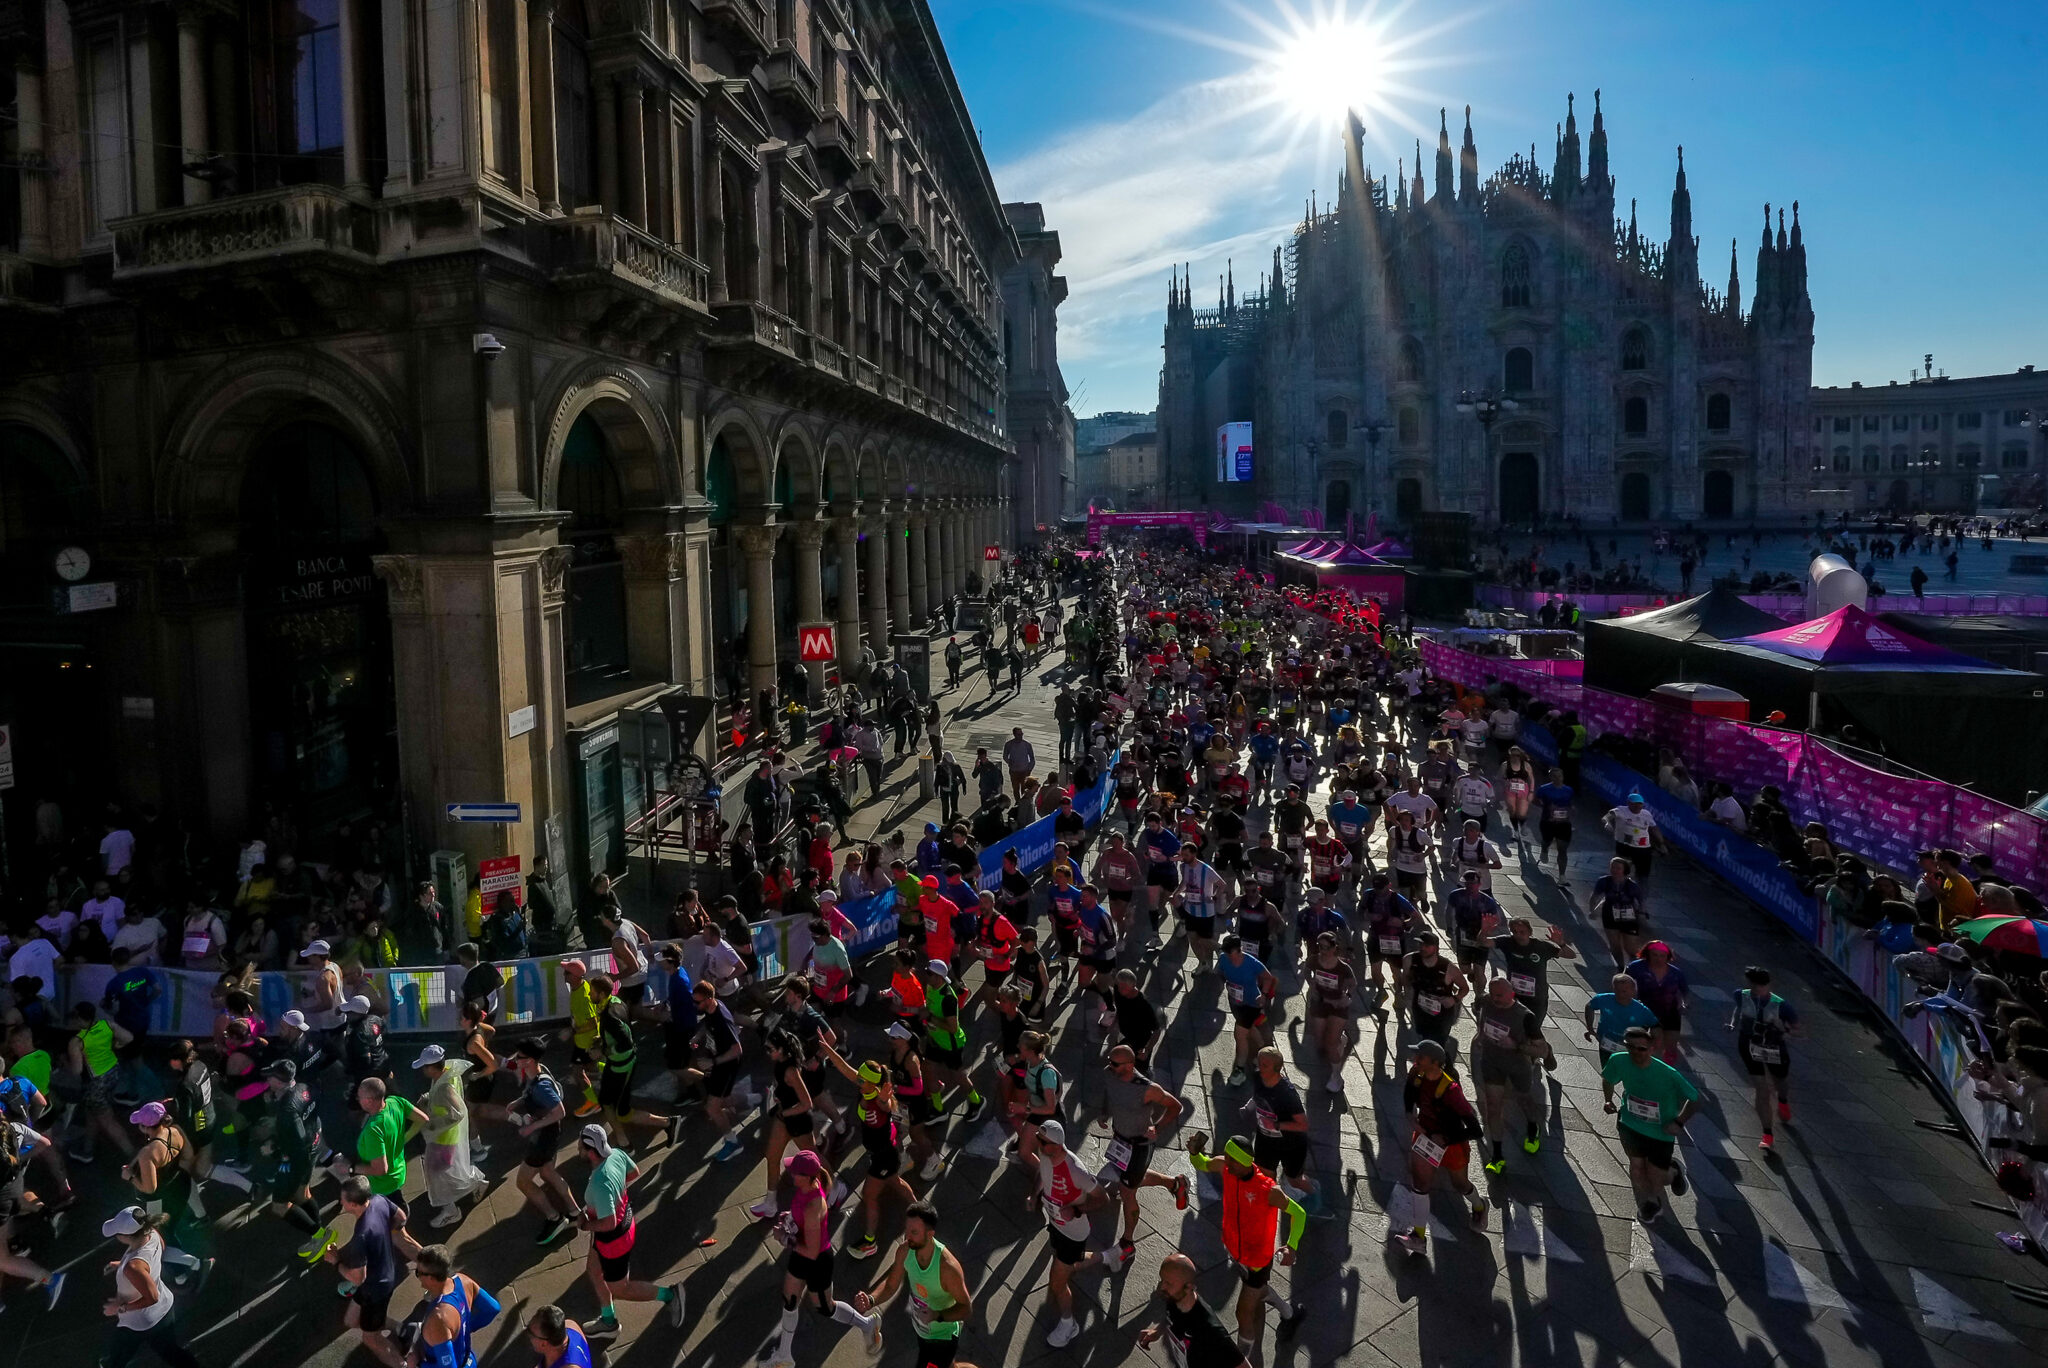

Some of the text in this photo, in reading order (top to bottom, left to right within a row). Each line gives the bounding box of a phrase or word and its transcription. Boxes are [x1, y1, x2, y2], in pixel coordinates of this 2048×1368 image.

[986, 547, 999, 558] M
[297, 556, 348, 577] BANCA
[333, 575, 372, 598] PONTI
[802, 633, 832, 655] M
[482, 874, 519, 886] MARATONA
